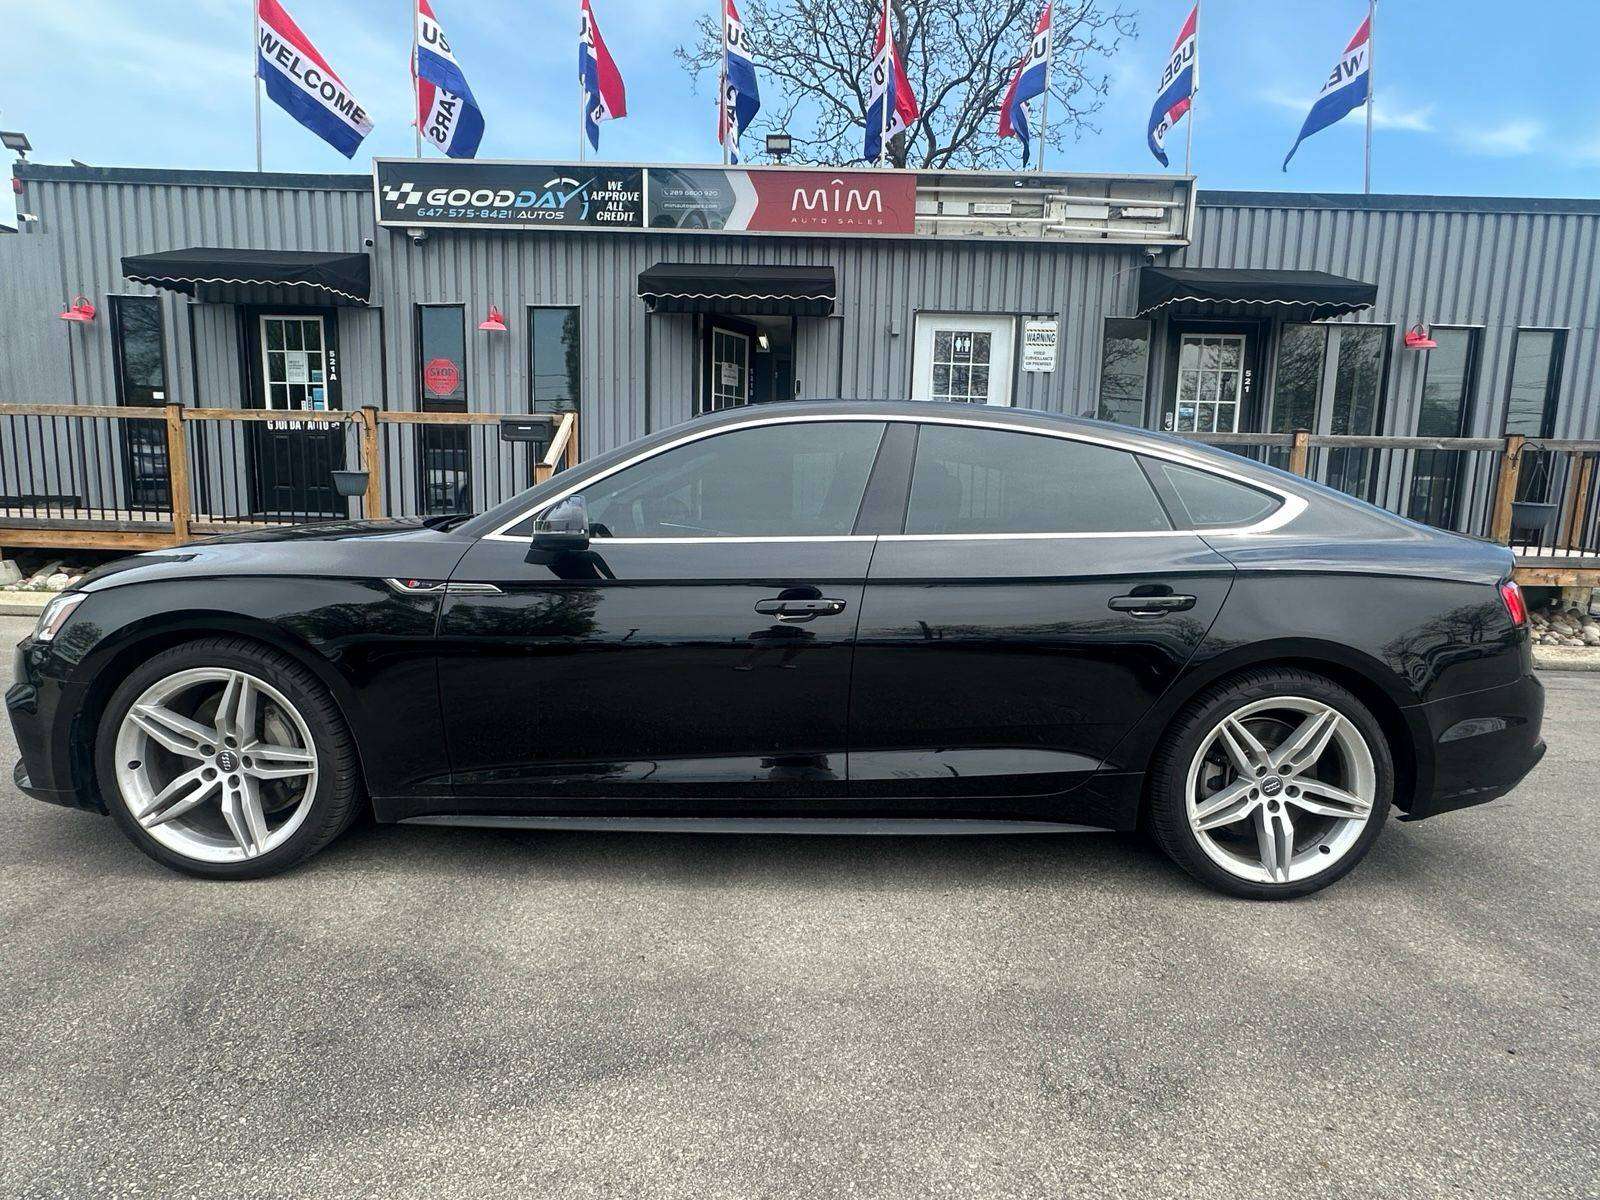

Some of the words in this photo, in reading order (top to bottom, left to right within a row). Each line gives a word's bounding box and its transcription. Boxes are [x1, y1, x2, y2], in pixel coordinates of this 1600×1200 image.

[260, 27, 366, 126] WELCOME
[607, 181, 624, 190] WE
[590, 191, 640, 201] APPROVE
[605, 202, 624, 212] ALL
[417, 208, 513, 218] 647-575-8421
[516, 210, 565, 220] AUTOS
[596, 211, 635, 222] CREDIT
[1026, 332, 1056, 343] WARNING
[329, 350, 337, 381] 521A
[430, 367, 455, 377] STOP
[1244, 370, 1252, 393] 521
